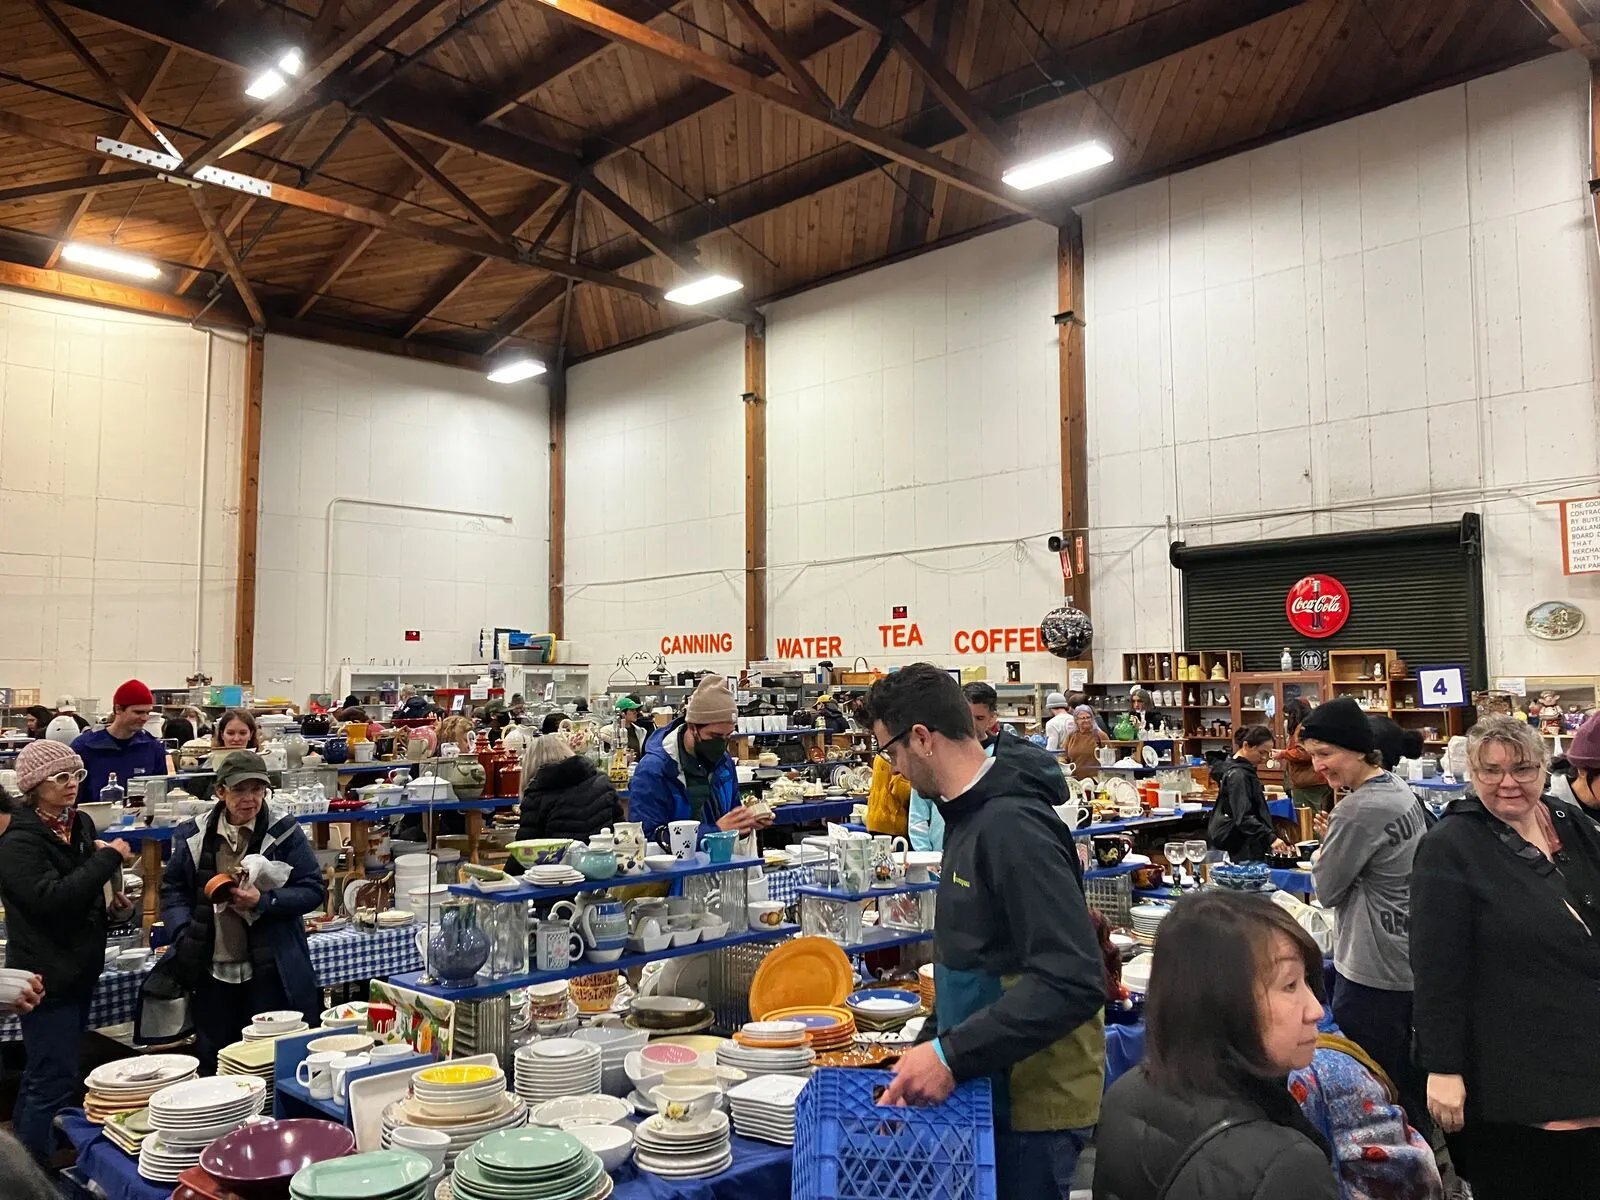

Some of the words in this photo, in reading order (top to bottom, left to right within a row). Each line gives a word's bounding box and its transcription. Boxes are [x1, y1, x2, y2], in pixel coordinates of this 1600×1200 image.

[1572, 532, 1594, 540] BOARD
[661, 632, 733, 655] CANNING
[878, 623, 924, 648] TEA
[776, 636, 842, 659] WATER
[1432, 677, 1448, 696] 4
